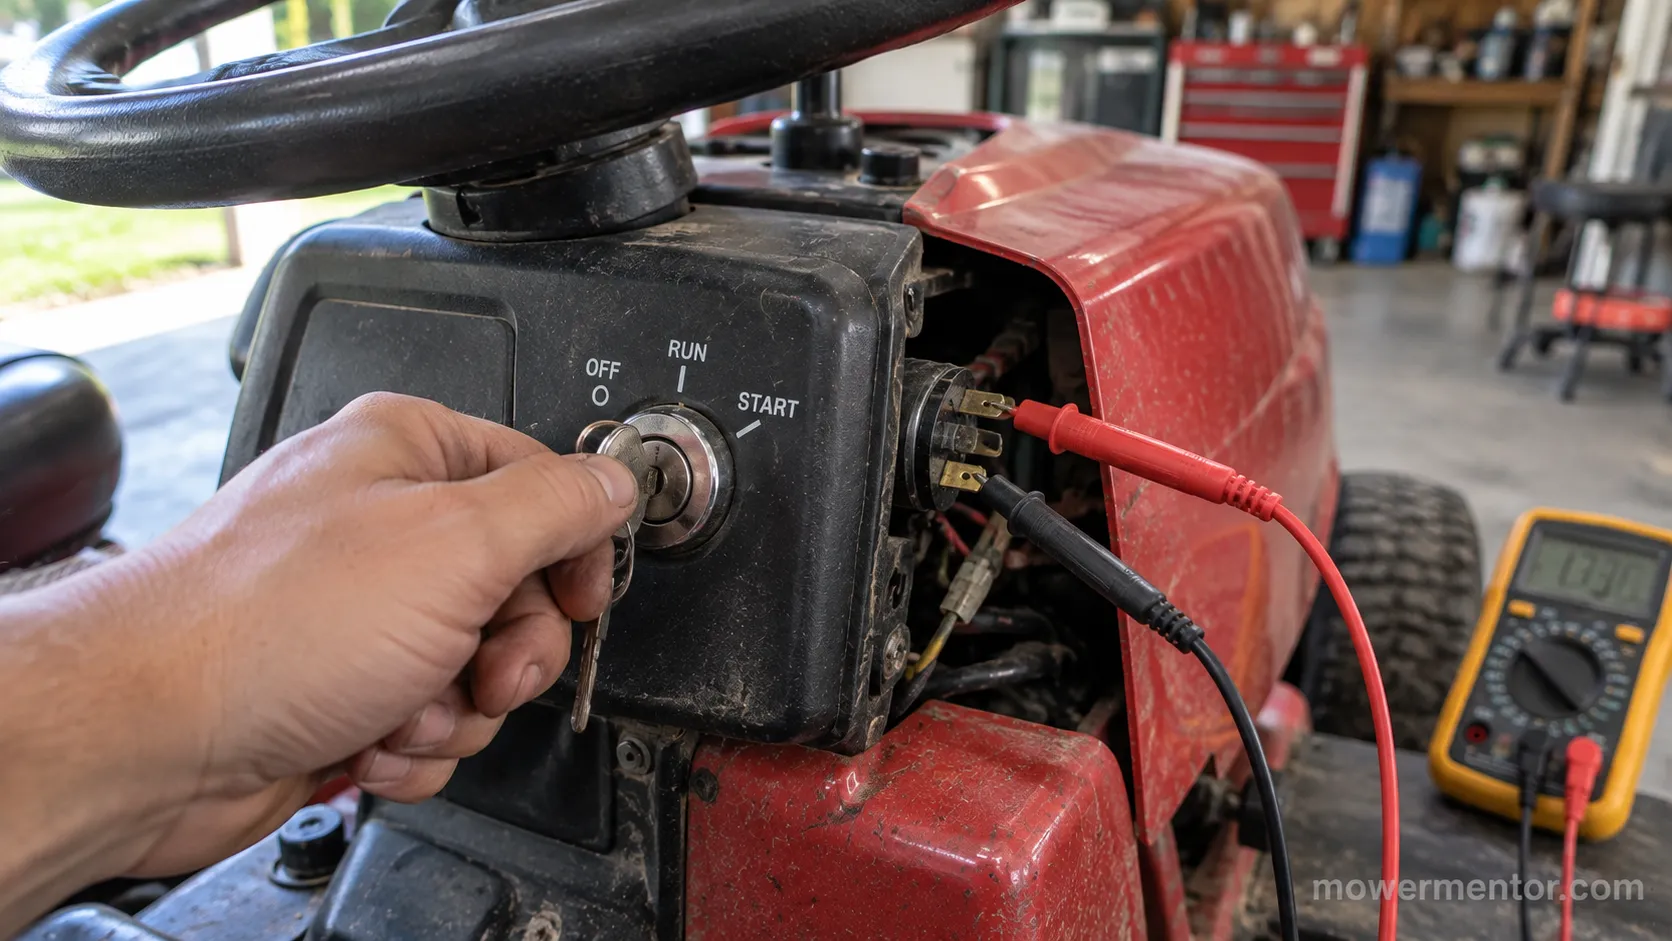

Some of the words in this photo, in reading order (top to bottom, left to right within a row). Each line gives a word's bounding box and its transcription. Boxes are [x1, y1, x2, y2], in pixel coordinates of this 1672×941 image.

[668, 340, 707, 362] RUN
[586, 358, 621, 380] OFF
[738, 392, 799, 418] START
